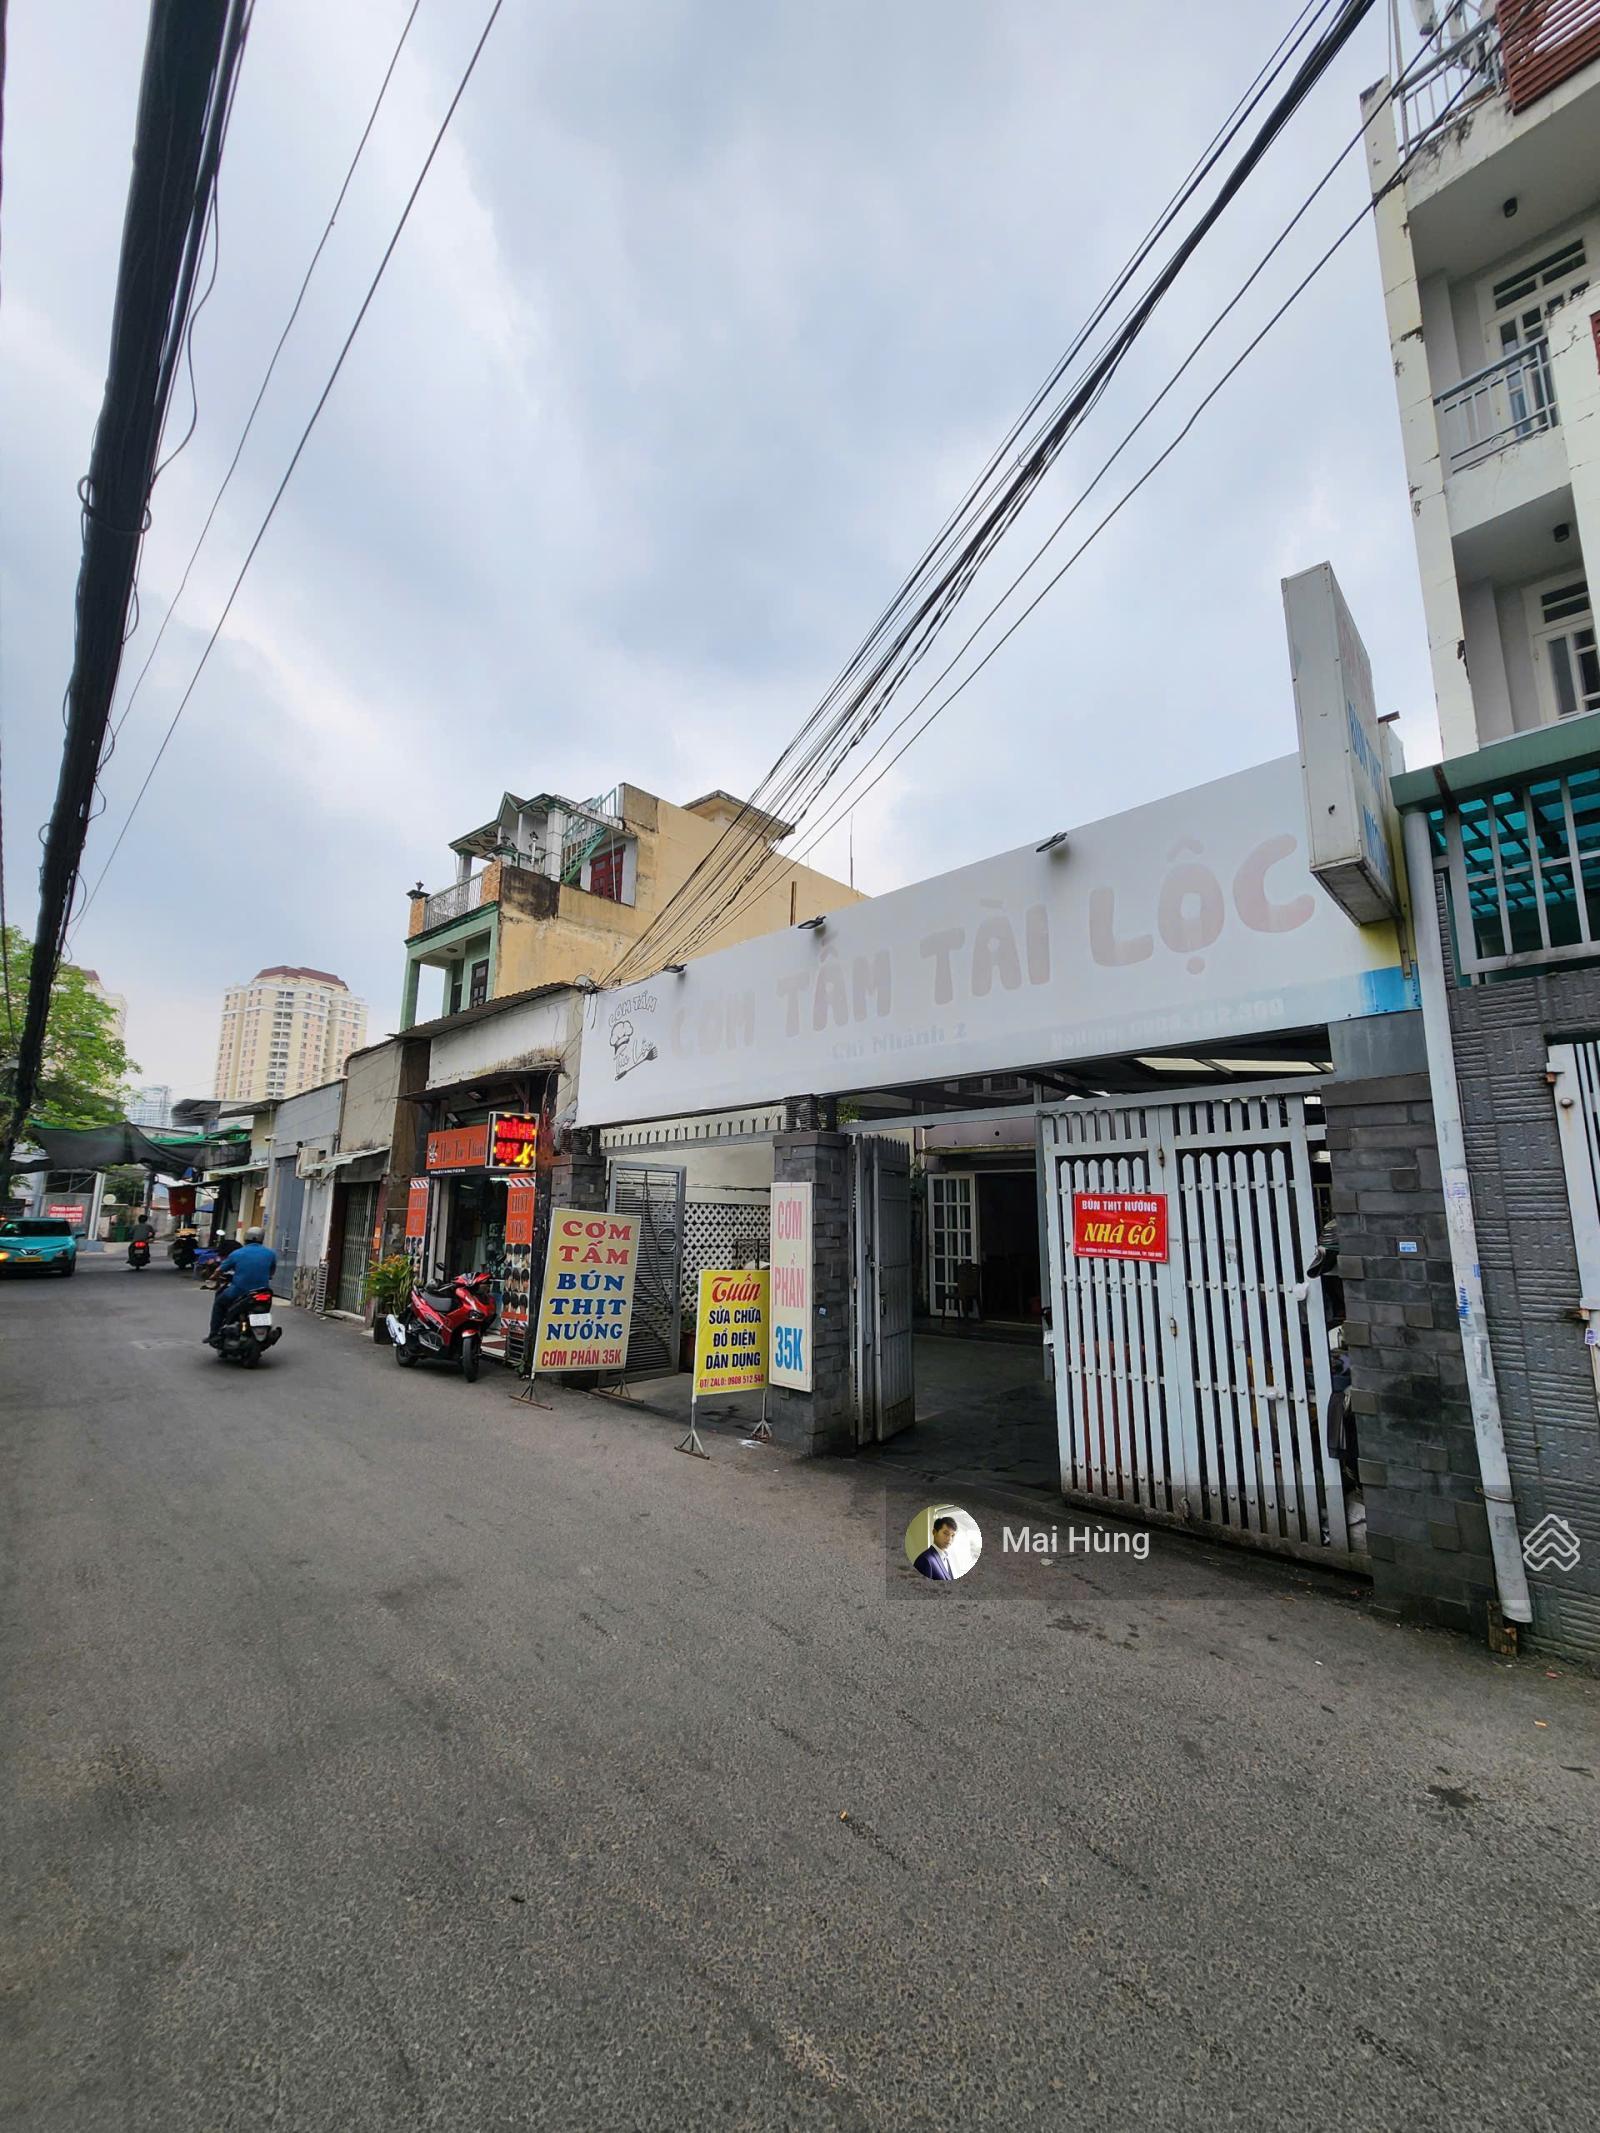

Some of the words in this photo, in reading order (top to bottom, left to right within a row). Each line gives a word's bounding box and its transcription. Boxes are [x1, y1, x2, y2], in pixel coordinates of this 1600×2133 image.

[919, 898, 1051, 1006] TÀI
[1088, 833, 1316, 976] LỘC
[1081, 1198, 1100, 1210] BÚN
[1102, 1200, 1122, 1213] THỊT
[1124, 1200, 1158, 1212] NƯỚNG
[777, 1197, 802, 1240] CƠM
[562, 1220, 632, 1241] CƠM
[1084, 1218, 1125, 1244] NHÀ
[1127, 1216, 1156, 1245] GỖ
[559, 1240, 629, 1265] TẤM
[556, 1270, 625, 1291] BÚN
[711, 1273, 761, 1303] Tuấn
[549, 1298, 627, 1320] THỊT
[708, 1305, 731, 1325] SỬA
[734, 1306, 762, 1324] CHỮA
[546, 1318, 623, 1341] NƯỚNG
[731, 1329, 756, 1349] ĐIỆN
[541, 1349, 567, 1367] CƠM
[602, 1349, 622, 1365] 35K
[775, 1326, 804, 1372] 35K
[706, 1351, 729, 1370] DÂN
[732, 1351, 761, 1371] DỤNG
[710, 1377, 727, 1387] ZALO:
